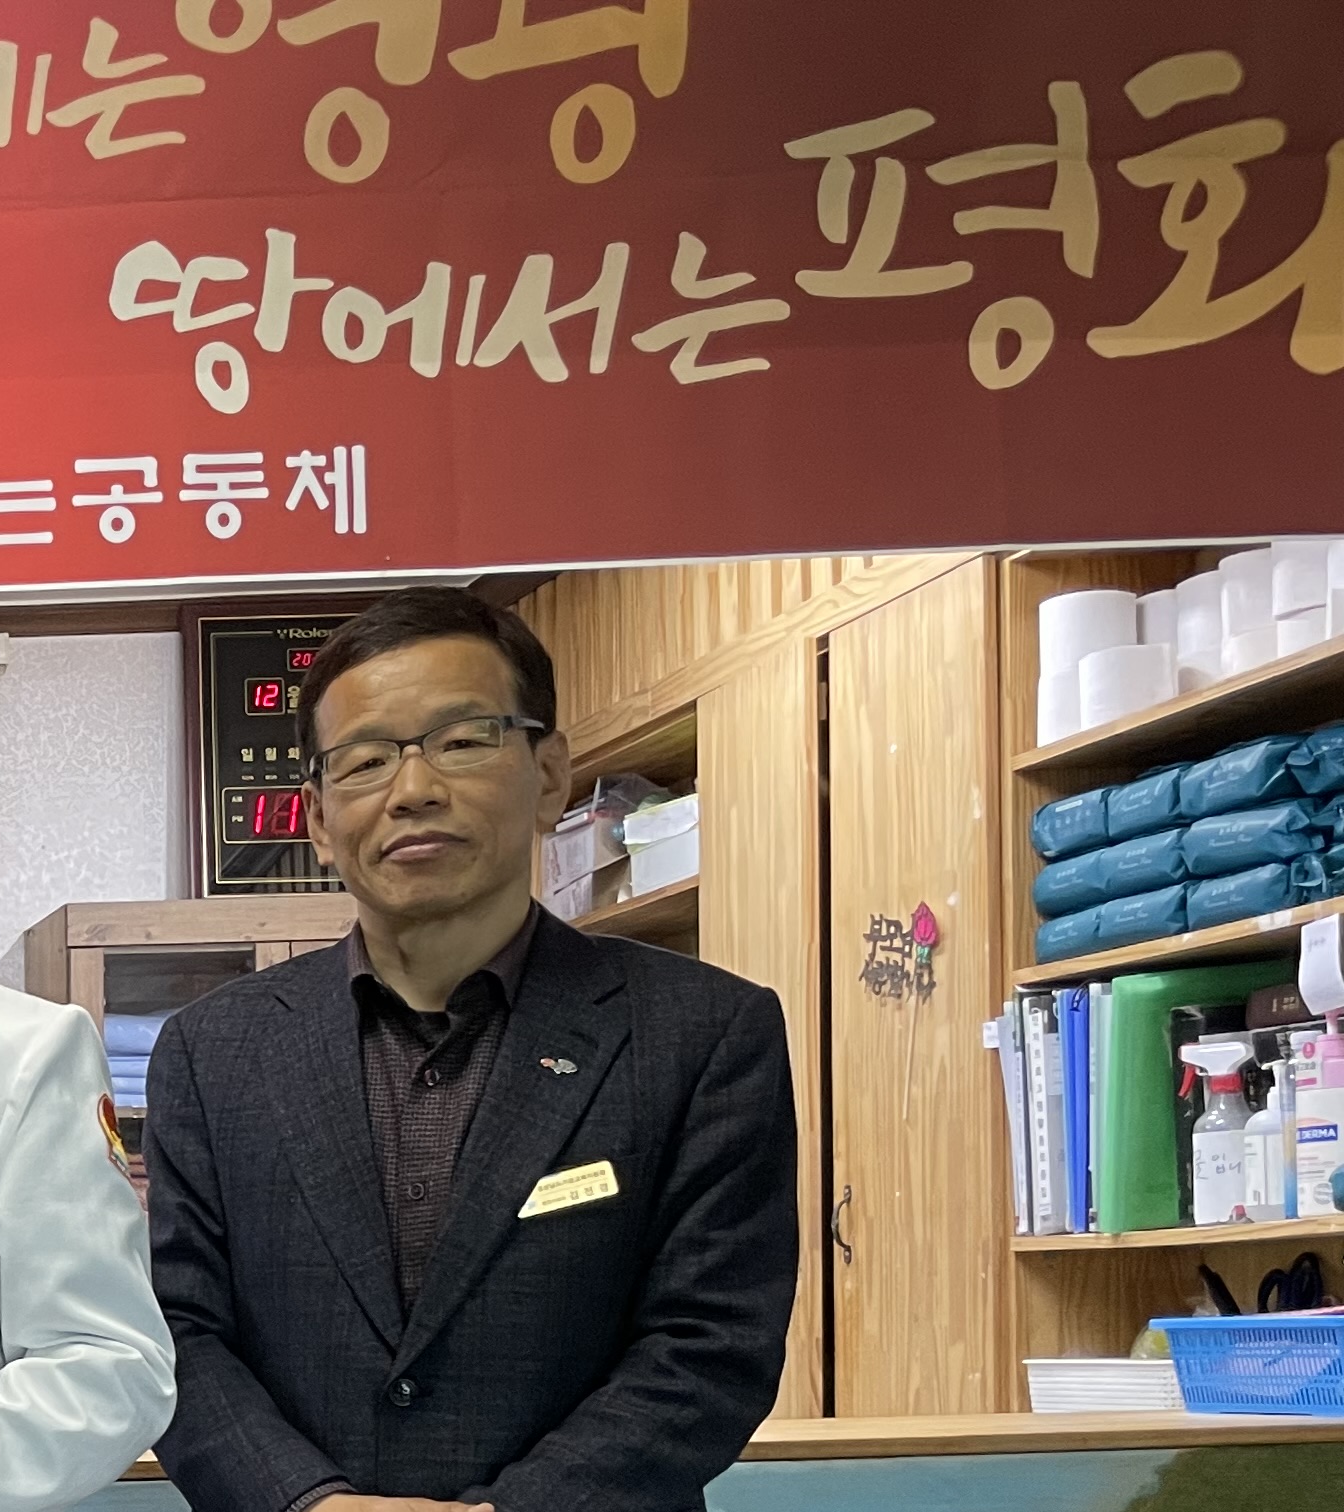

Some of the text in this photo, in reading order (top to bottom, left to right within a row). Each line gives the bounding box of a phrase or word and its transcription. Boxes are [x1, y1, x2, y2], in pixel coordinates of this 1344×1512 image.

[109, 50, 1344, 415] 땅에서는 평화
[254, 684, 279, 708] 12
